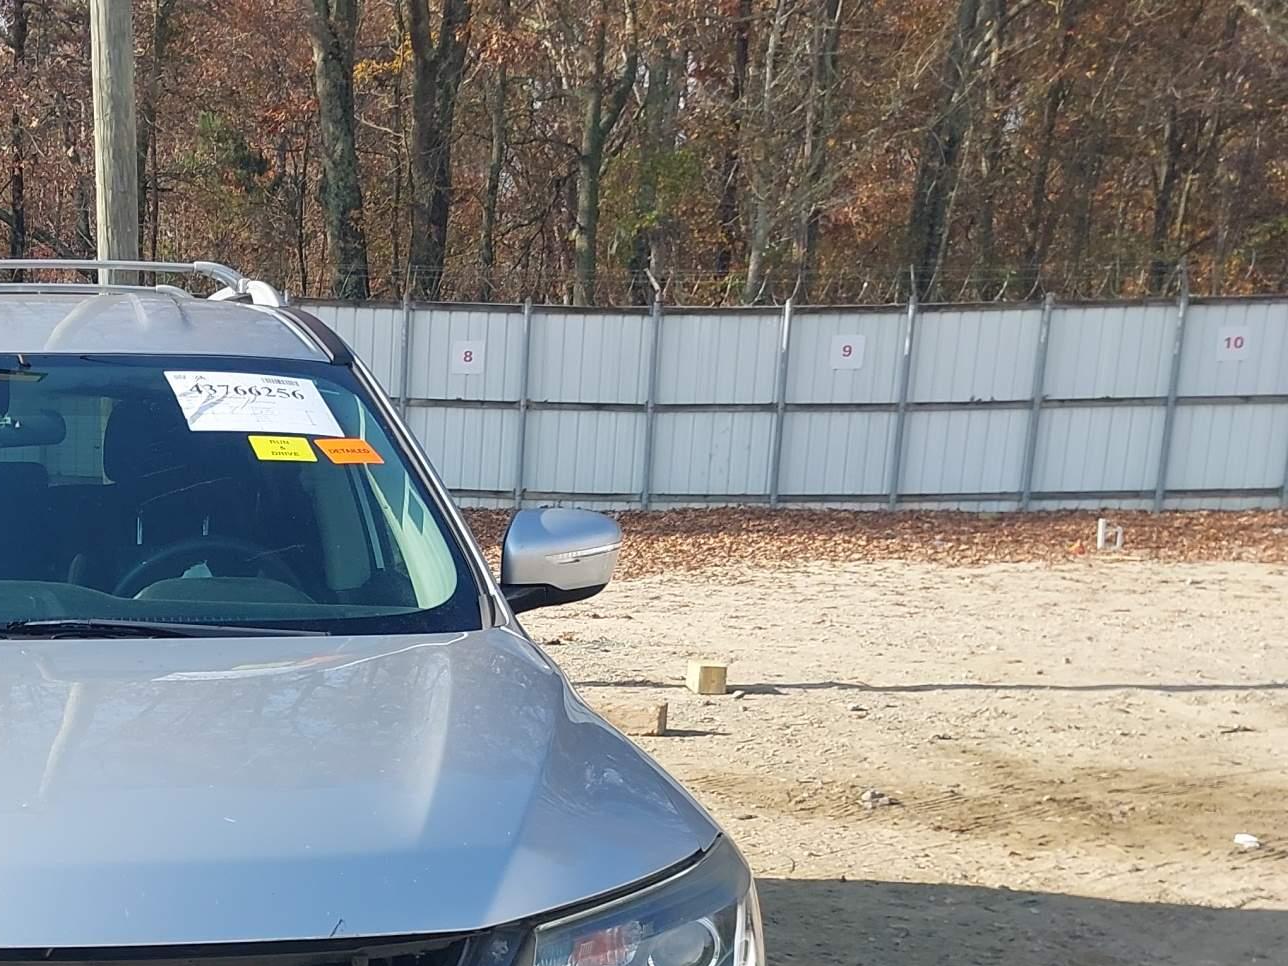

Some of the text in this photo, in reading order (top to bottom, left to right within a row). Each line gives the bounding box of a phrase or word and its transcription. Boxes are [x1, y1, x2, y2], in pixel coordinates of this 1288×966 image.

[1224, 336, 1244, 349] 10
[463, 350, 473, 363] 8
[842, 344, 852, 357] 9
[190, 382, 304, 400] 43766256
